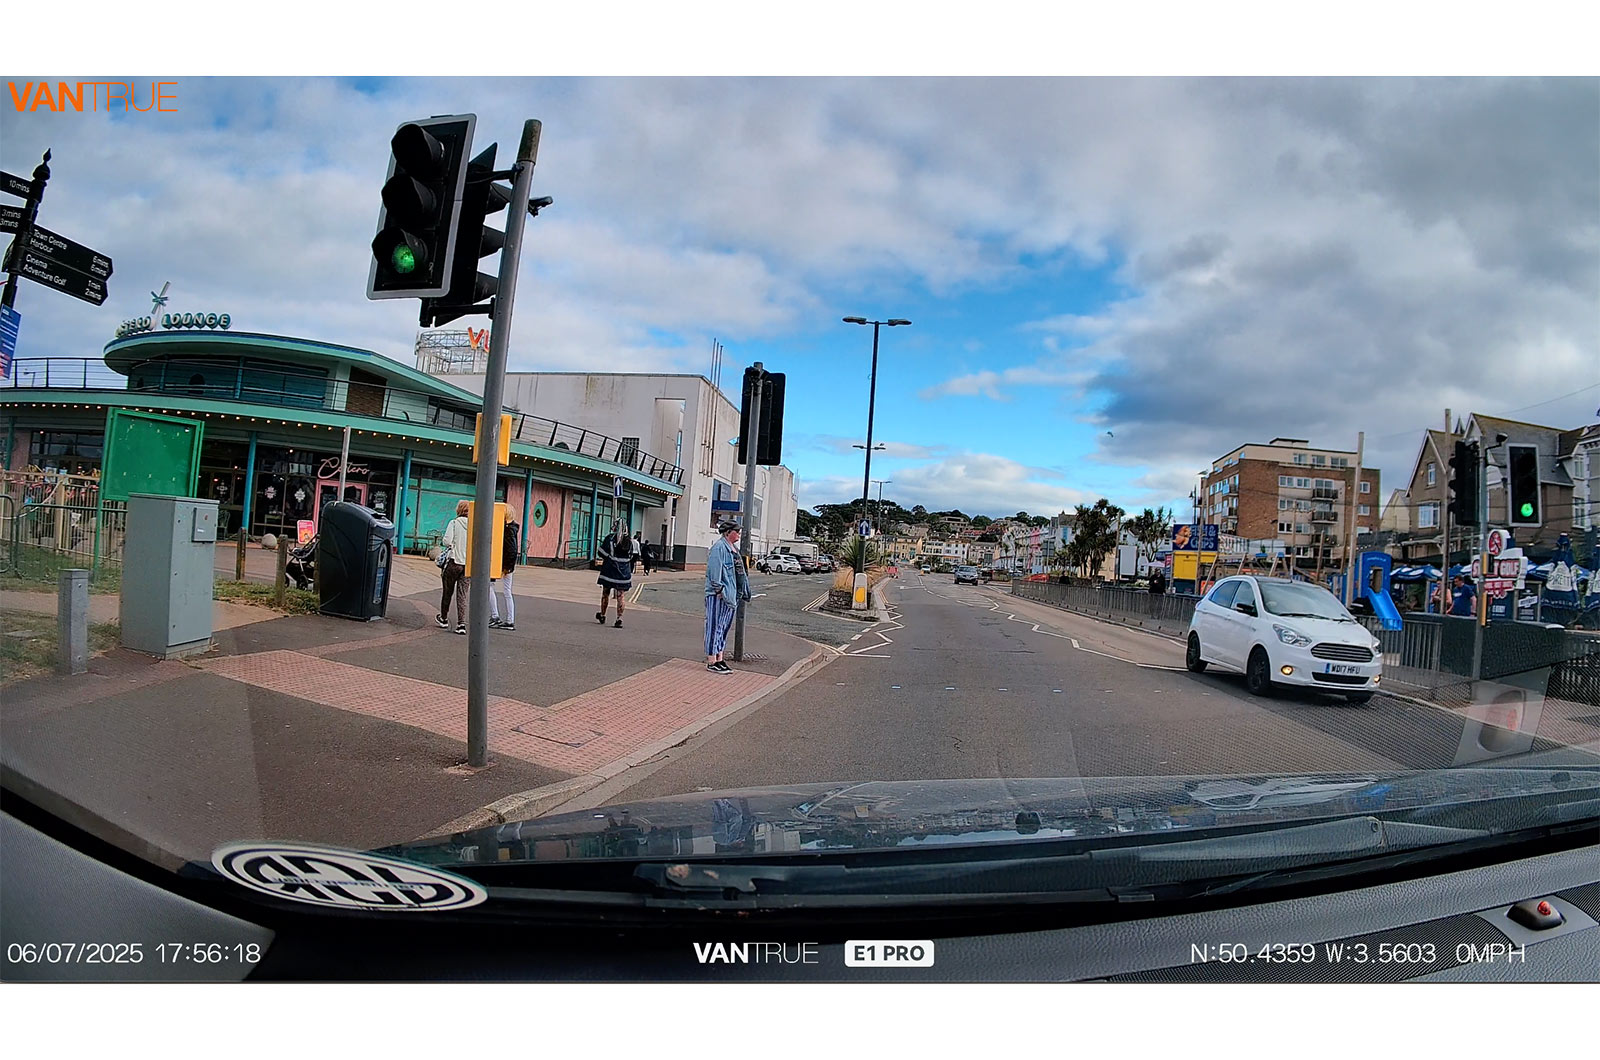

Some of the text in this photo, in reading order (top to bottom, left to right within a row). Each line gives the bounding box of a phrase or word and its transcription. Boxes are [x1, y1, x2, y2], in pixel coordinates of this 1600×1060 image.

[30, 238, 54, 253] Harbour
[33, 229, 48, 241] Town
[48, 236, 68, 250] Centre
[26, 254, 48, 269] Cinema
[23, 264, 54, 282] Adventure
[54, 275, 68, 286] Golf
[162, 313, 230, 328] LOUNGE
[1190, 525, 1208, 537] FIH
[1500, 560, 1519, 576] GOLF
